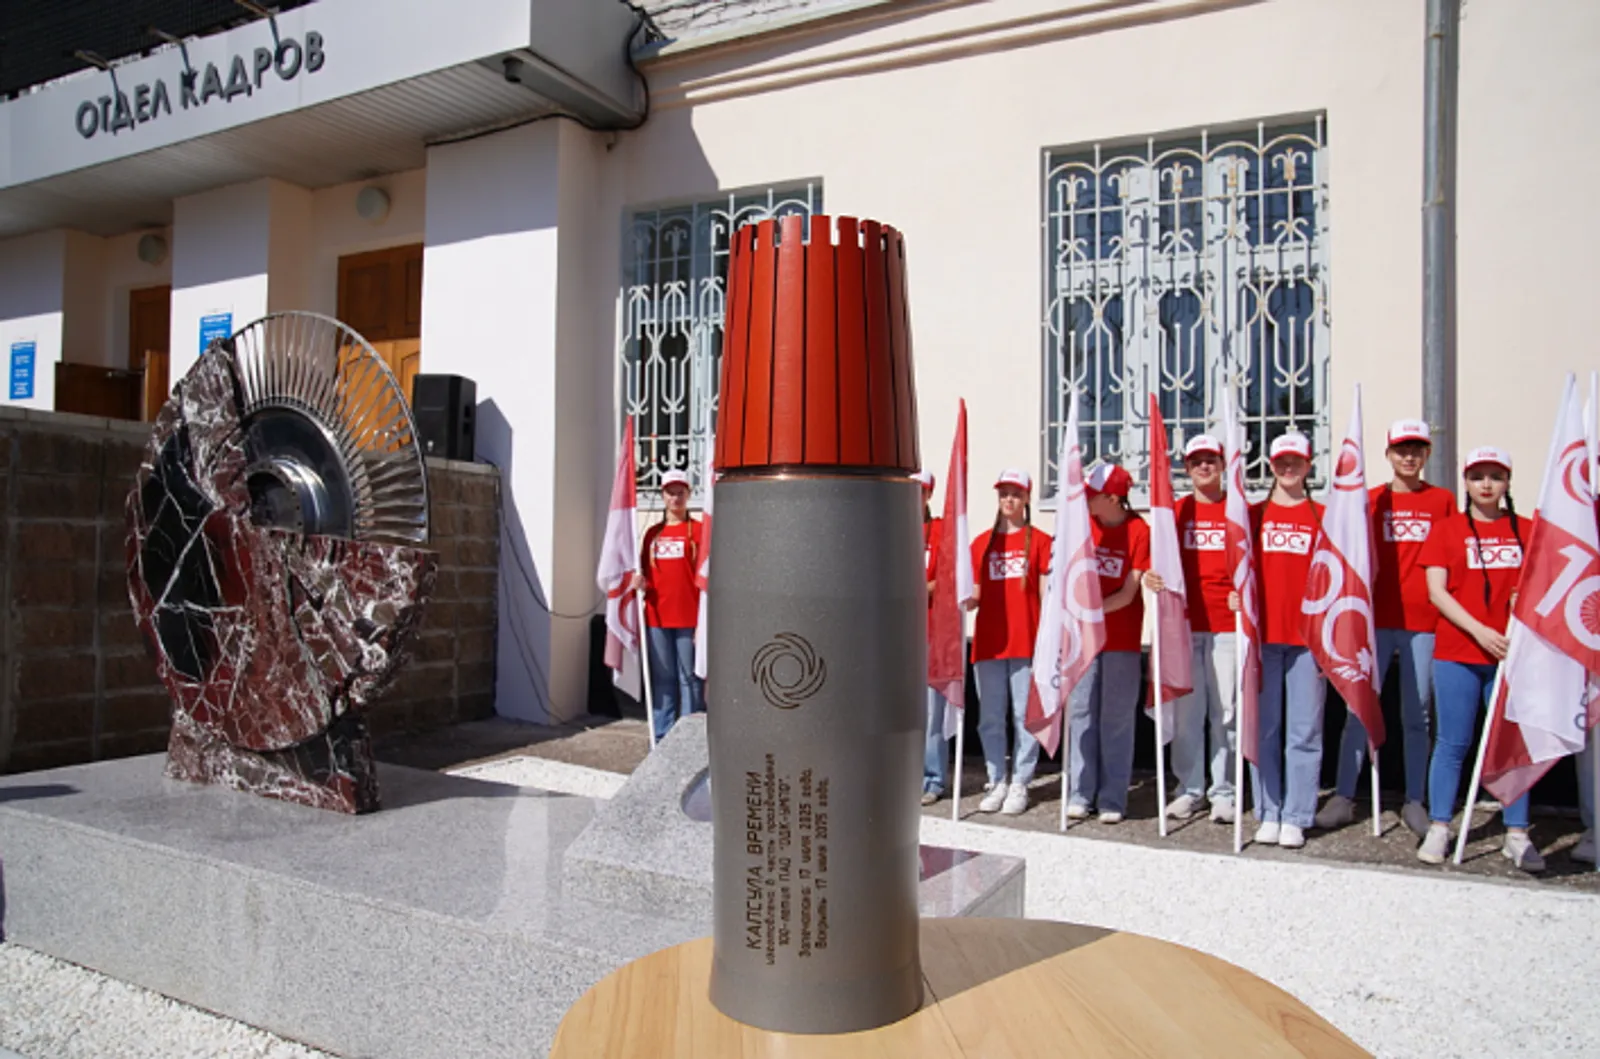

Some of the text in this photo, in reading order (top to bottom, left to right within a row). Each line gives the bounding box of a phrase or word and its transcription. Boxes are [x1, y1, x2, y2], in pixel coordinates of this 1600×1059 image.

[75, 31, 325, 139] ОТДЕЛ КАДРОВ
[814, 813, 828, 839] 2075
[746, 771, 762, 950] КАПСУЛА ВРЕМЕНИ
[778, 857, 791, 882] ПАО
[798, 868, 811, 879] 17
[814, 878, 827, 890] 17
